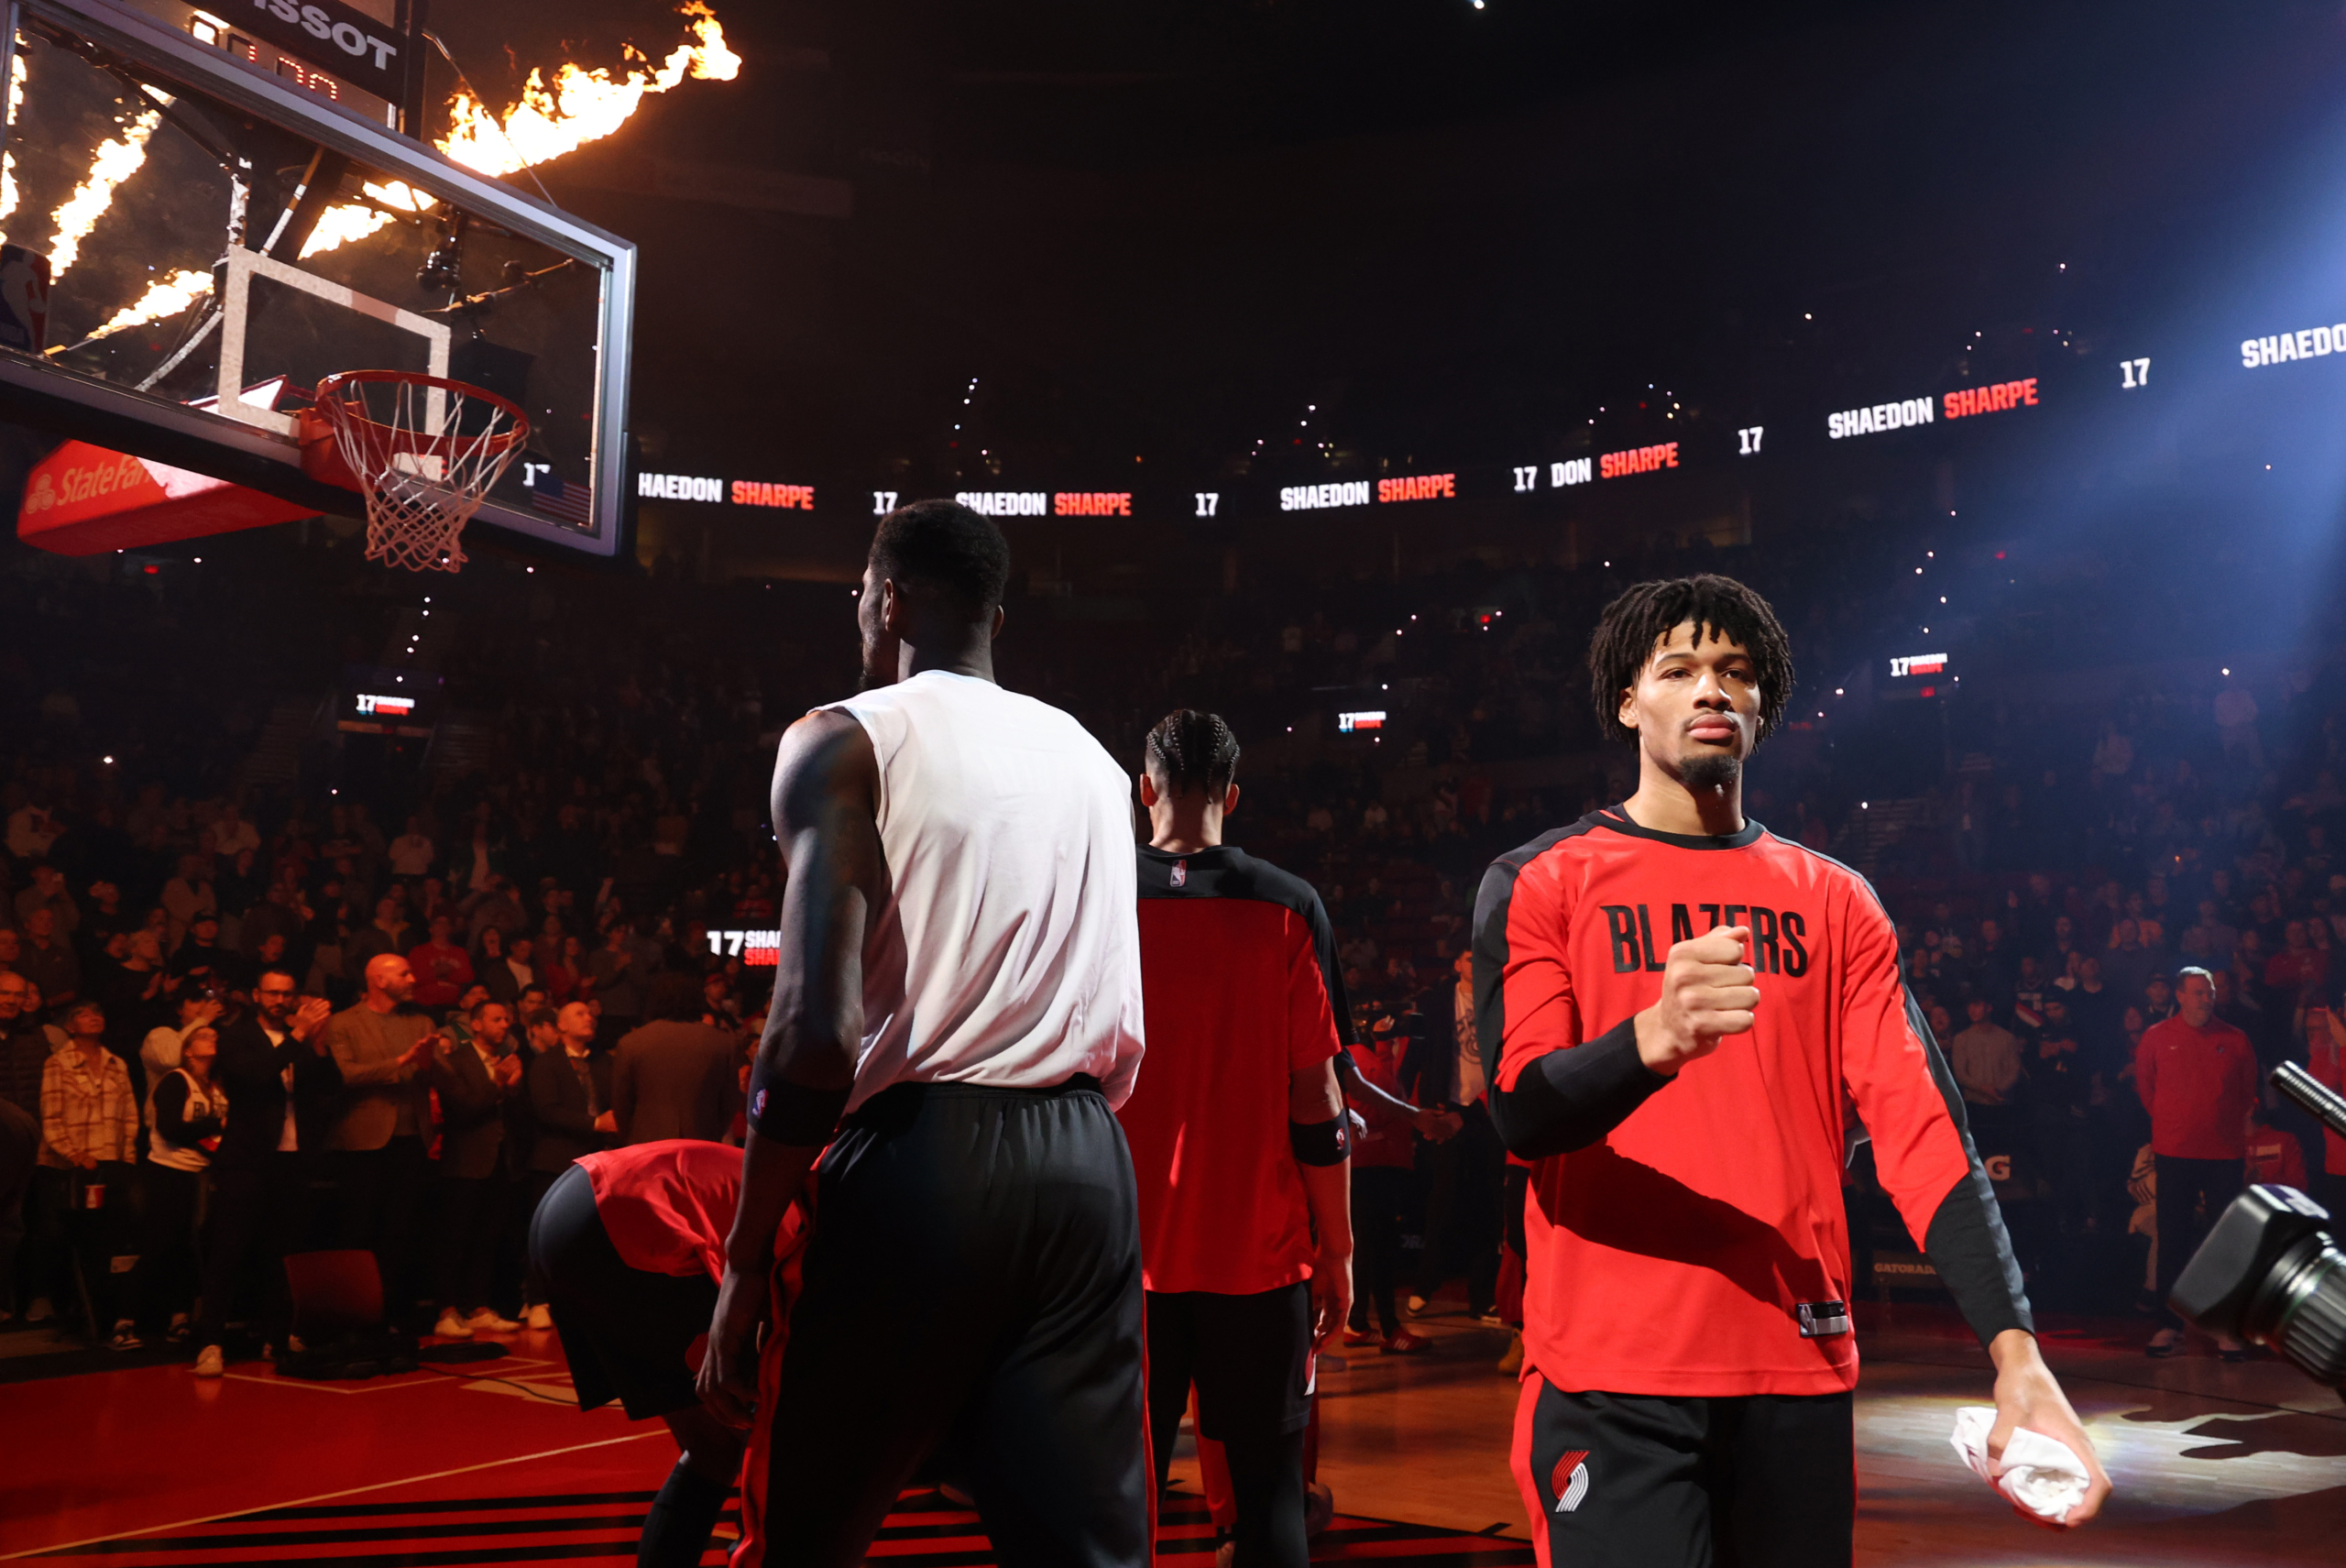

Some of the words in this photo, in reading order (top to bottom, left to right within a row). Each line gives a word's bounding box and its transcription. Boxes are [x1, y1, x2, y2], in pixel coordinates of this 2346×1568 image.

[253, 0, 397, 71] SSOT
[2120, 357, 2151, 389] 17
[1827, 396, 1935, 440] SHAEDON
[1943, 378, 2040, 420] SHARPE
[1738, 425, 1764, 455] 17
[1550, 456, 1592, 488] DON
[1599, 441, 1680, 479] SHARPE
[637, 472, 723, 503] HAEDON
[730, 479, 815, 510] SHARPE
[1280, 480, 1370, 511] SHAEDON
[1377, 473, 1456, 503] SHARPE
[1513, 466, 1538, 492] 17
[872, 491, 898, 515] 17
[955, 491, 1047, 516] SHAEDON
[1054, 491, 1133, 517] SHARPE
[1195, 492, 1220, 517] 17
[1890, 657, 1910, 676] 17
[356, 694, 377, 712] 17
[1338, 712, 1355, 730] 17
[707, 930, 744, 957] 17
[1983, 1155, 2012, 1181] G
[1873, 1262, 1937, 1276] GATORAD
